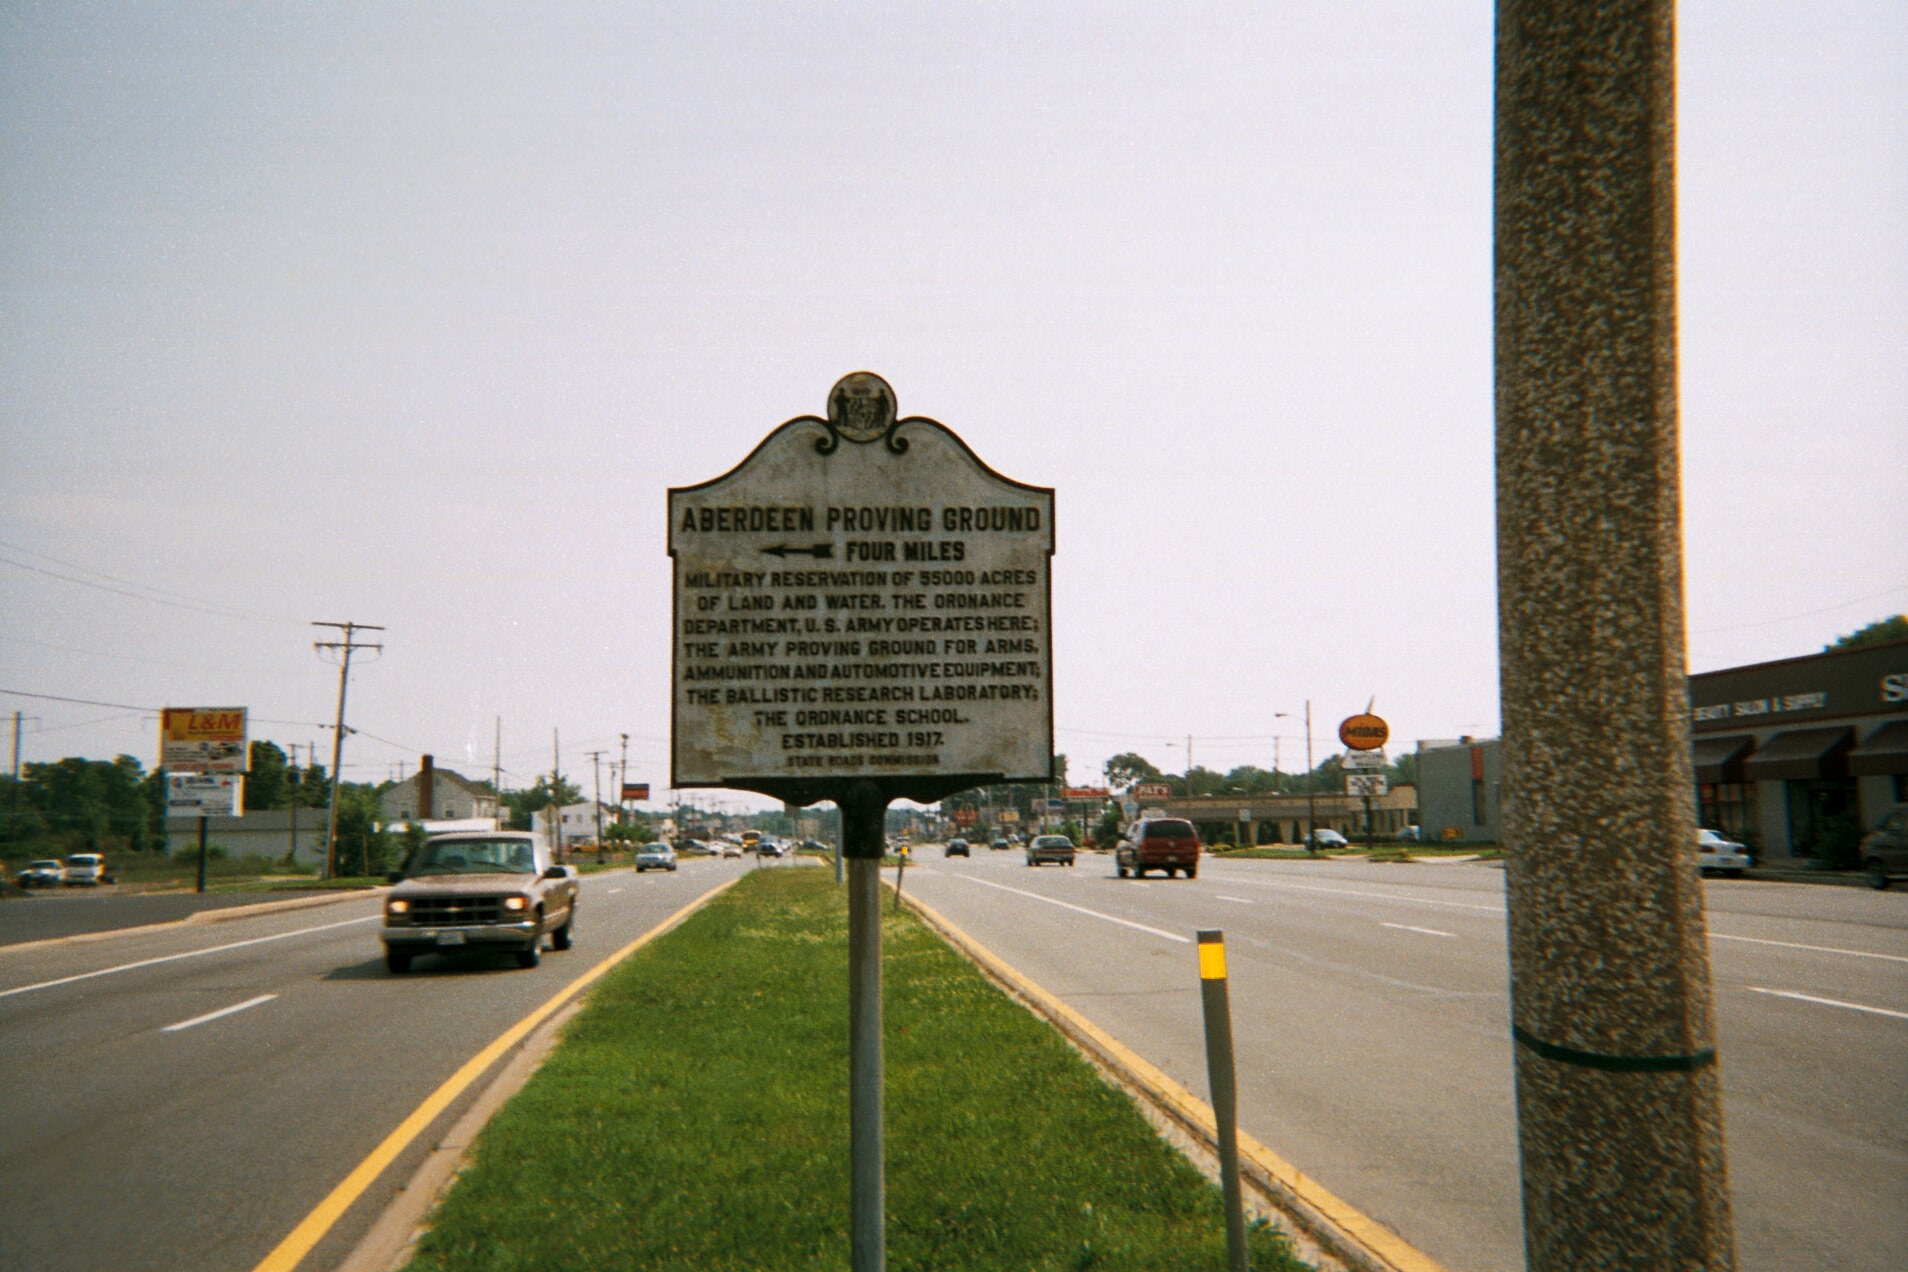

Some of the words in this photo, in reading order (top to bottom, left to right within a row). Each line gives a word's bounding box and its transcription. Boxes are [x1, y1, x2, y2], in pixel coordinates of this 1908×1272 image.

[681, 506, 814, 532] ABERDEEN
[826, 506, 932, 532] PROVING
[942, 506, 1041, 532] GROUND
[845, 541, 896, 562] FOUR
[903, 541, 966, 562] MILES
[685, 571, 766, 588] MILITARY
[770, 570, 887, 587] RESERVATION
[891, 570, 914, 586] OF
[919, 570, 975, 586] 55000
[979, 569, 1038, 585] ACRES
[697, 595, 720, 611] OF
[728, 594, 775, 611] LAND
[782, 594, 818, 610] AND
[892, 593, 927, 610] THE
[934, 592, 1025, 609] ORDNANCE
[845, 616, 894, 632] ARMY
[897, 616, 985, 632] OPERATES
[684, 642, 720, 658] THE
[727, 641, 778, 657] ARMY
[786, 640, 861, 657] PROVING
[868, 639, 937, 656] GROUND
[944, 639, 978, 655] FOR
[684, 664, 791, 681] AMMUNITION
[794, 663, 829, 680] AND
[831, 662, 942, 679] AUTOMOTIVE
[686, 687, 721, 704] THE
[725, 686, 819, 704] BALLISTIC
[822, 685, 914, 703] RESEARCH
[187, 713, 242, 730] L&M
[754, 710, 788, 727] THE
[795, 709, 888, 726] ORDNANCE
[895, 707, 970, 725] SCHOOL.
[782, 731, 900, 750] ESTABLISHED
[907, 730, 945, 748] 1917.
[1345, 726, 1386, 737] MIDAS
[786, 755, 824, 768] STATE
[828, 754, 865, 768] ROADS
[868, 753, 940, 767] COMMISSION
